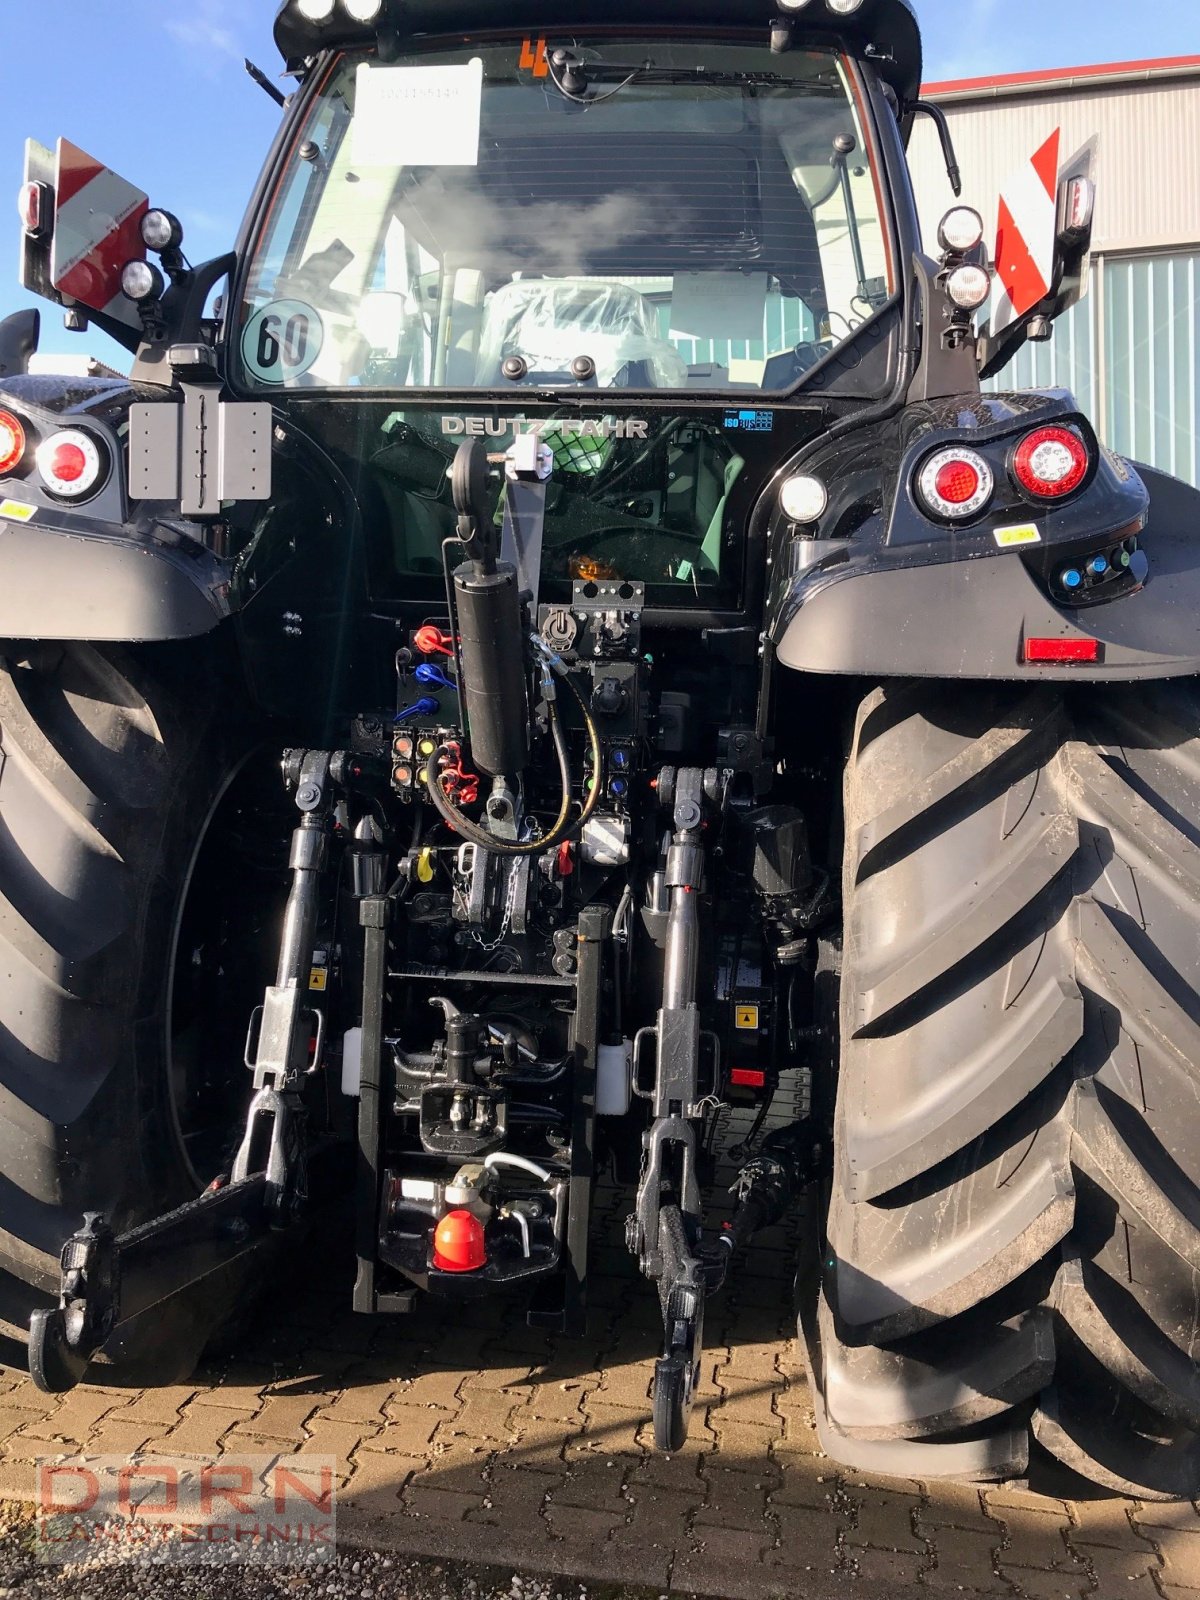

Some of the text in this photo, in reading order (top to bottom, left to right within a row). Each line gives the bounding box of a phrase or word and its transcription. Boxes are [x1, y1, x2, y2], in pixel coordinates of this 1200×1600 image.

[256, 314, 309, 368] 60
[441, 416, 648, 439] DEUTZ-FAHR
[724, 417, 756, 429] ISOBUS
